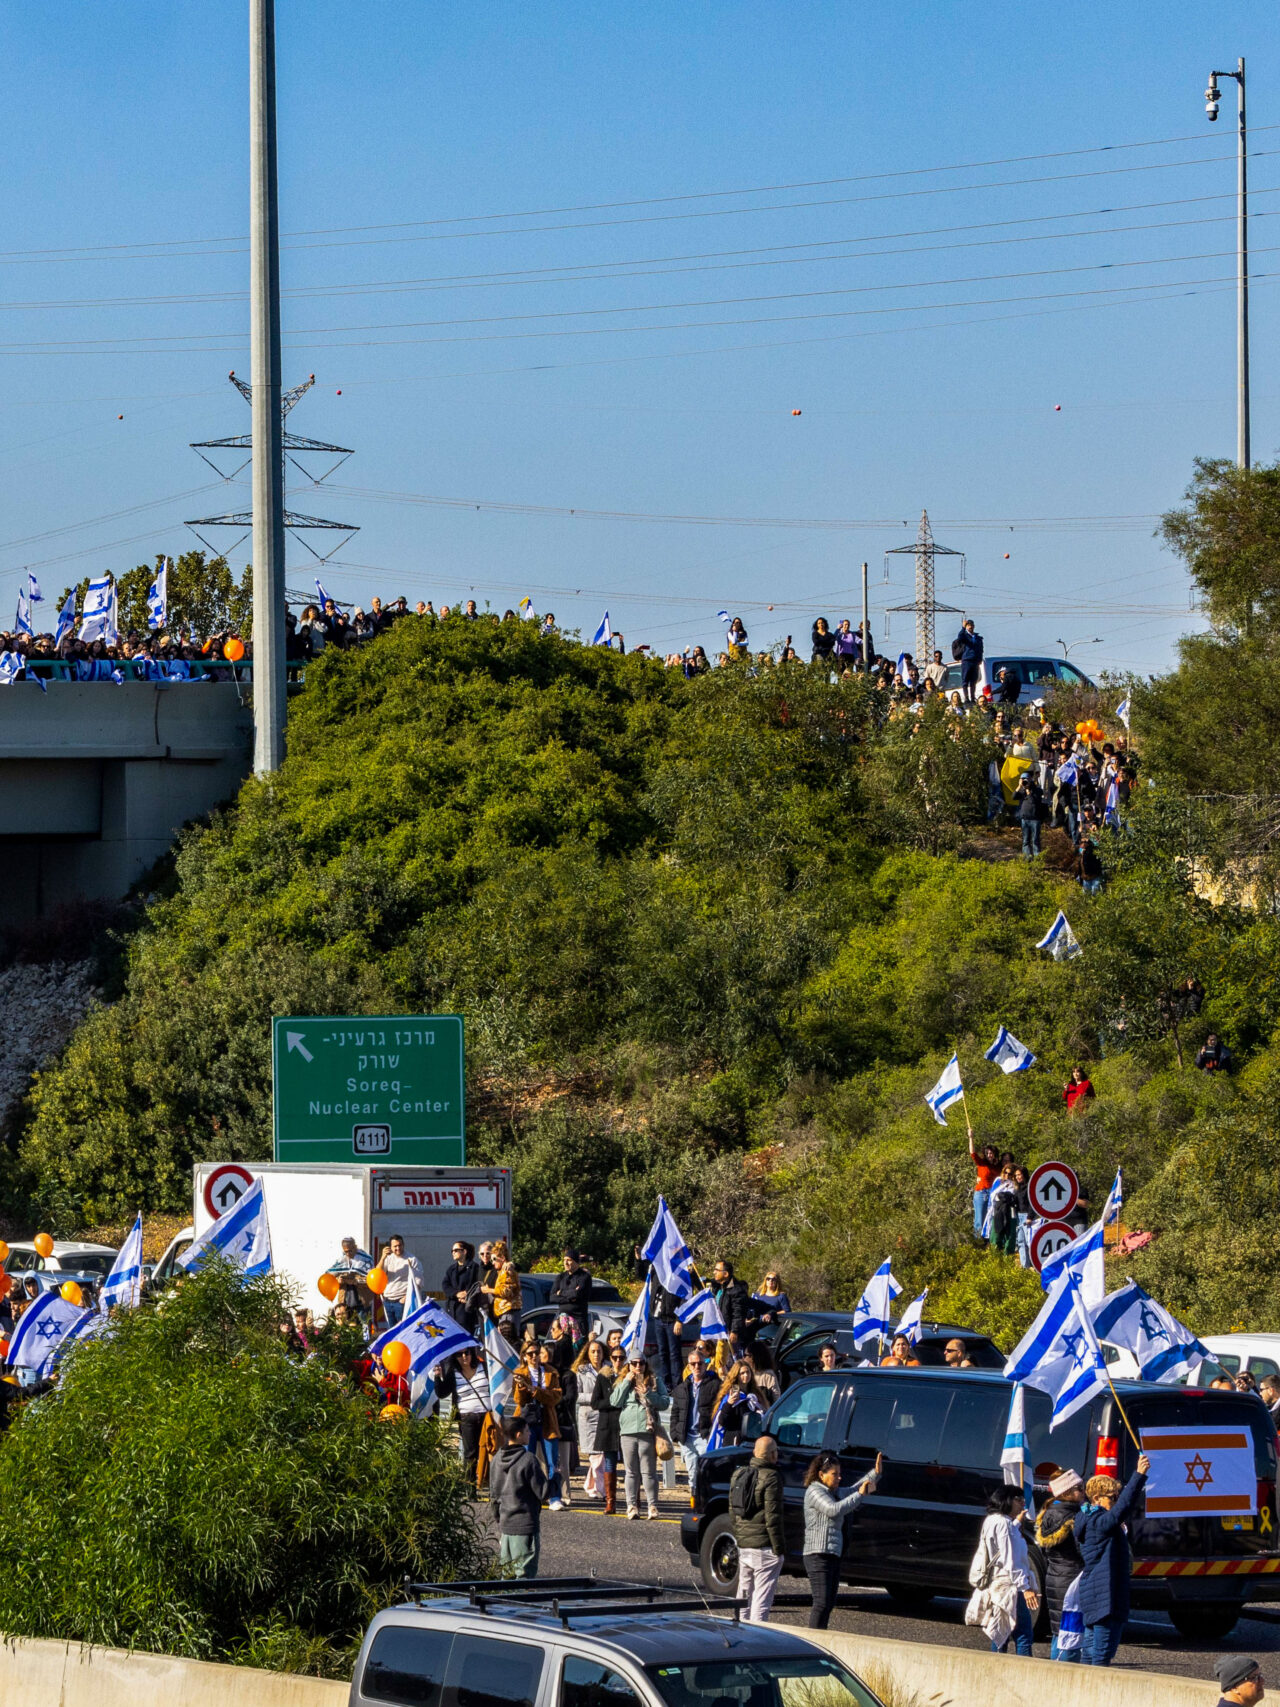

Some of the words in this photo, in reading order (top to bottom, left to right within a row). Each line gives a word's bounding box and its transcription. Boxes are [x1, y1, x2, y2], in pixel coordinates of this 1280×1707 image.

[395, 1031, 436, 1046] מרכז
[358, 1054, 400, 1072] שורק
[309, 1100, 379, 1115] Nuclear
[389, 1099, 450, 1113] Center
[358, 1132, 386, 1147] 4111
[403, 1191, 475, 1206] מריומה
